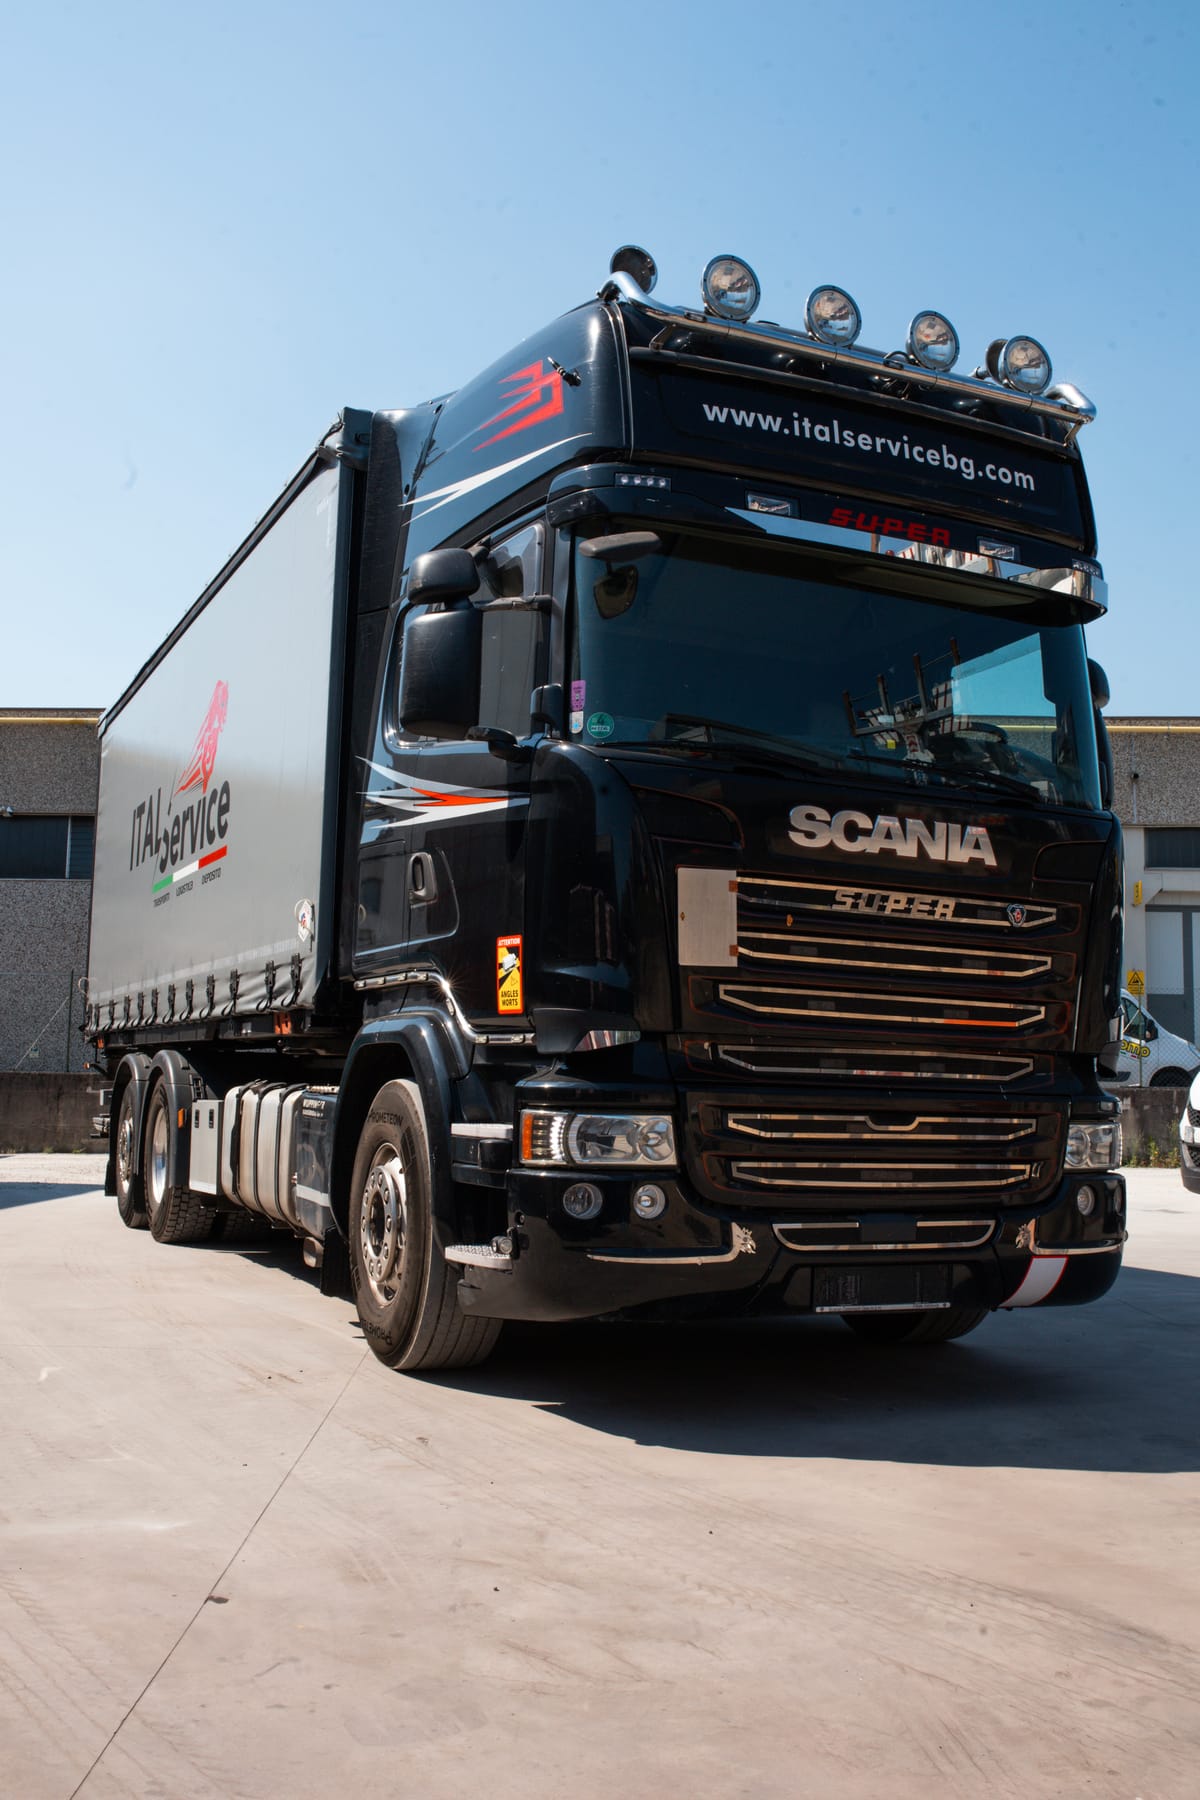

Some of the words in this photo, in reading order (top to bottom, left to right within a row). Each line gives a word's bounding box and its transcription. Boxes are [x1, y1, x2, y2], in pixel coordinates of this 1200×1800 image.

[702, 403, 1036, 491] www.italservicebg.com
[828, 507, 951, 546] SUPER
[788, 805, 998, 867] SCANIA
[831, 888, 956, 921] SUPER
[501, 990, 518, 998] ANGLES
